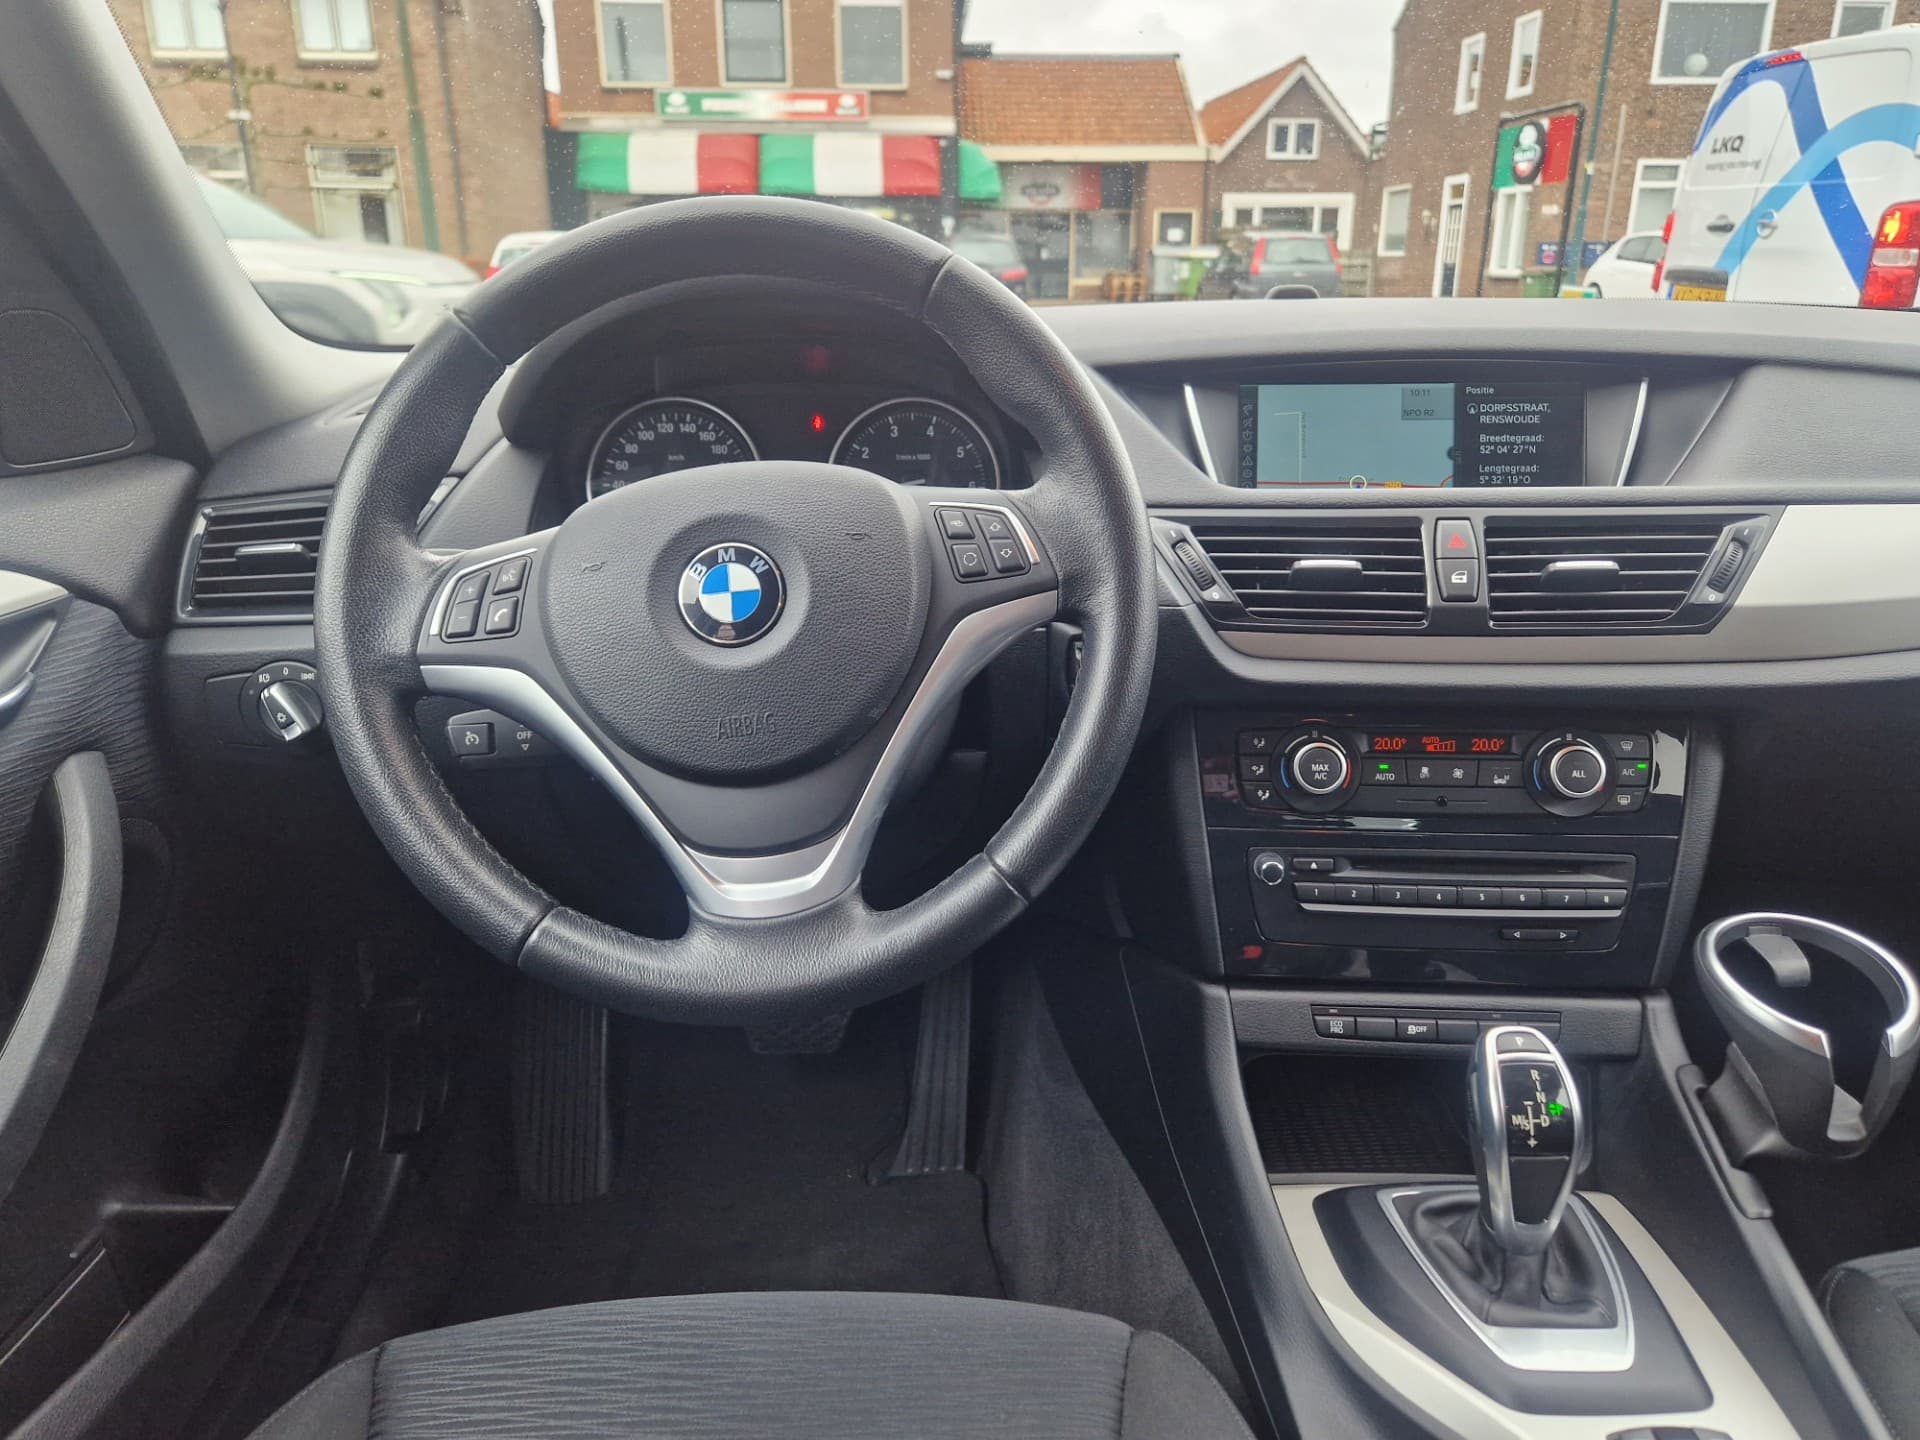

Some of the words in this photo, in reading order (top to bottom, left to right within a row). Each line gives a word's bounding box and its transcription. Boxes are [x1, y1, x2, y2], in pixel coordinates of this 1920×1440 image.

[1711, 135, 1744, 154] LKQ
[1465, 386, 1494, 395] Positie
[1403, 409, 1422, 417] NPO
[1423, 409, 1434, 417] R2
[1480, 403, 1551, 413] DORPSSTRAAT,
[1480, 415, 1541, 424] RENSWOUDE
[657, 423, 674, 433] 120
[680, 423, 696, 433] 140
[890, 426, 898, 438] 3
[926, 426, 934, 437] 4
[637, 431, 655, 441] 100
[699, 432, 716, 441] 160
[1479, 434, 1544, 444] Breedtegraad:
[625, 444, 638, 454] 80
[711, 445, 728, 455] 180
[862, 447, 869, 459] 2
[957, 447, 964, 458] 5
[615, 461, 629, 471] 60
[1479, 464, 1540, 475] Lengtegraad:
[612, 480, 625, 489] 40
[688, 548, 769, 581] BMW
[718, 711, 776, 740] AIRBAG
[516, 731, 533, 740] OFF
[1422, 736, 1440, 744] AUTO
[1311, 763, 1329, 771] MAX
[1622, 768, 1635, 776] A/C
[1314, 772, 1327, 780] A/C
[1571, 770, 1586, 778] ALL
[1416, 1025, 1427, 1033] OFF
[1530, 1069, 1541, 1081] R
[1536, 1091, 1547, 1103] N
[1540, 1115, 1551, 1127] D
